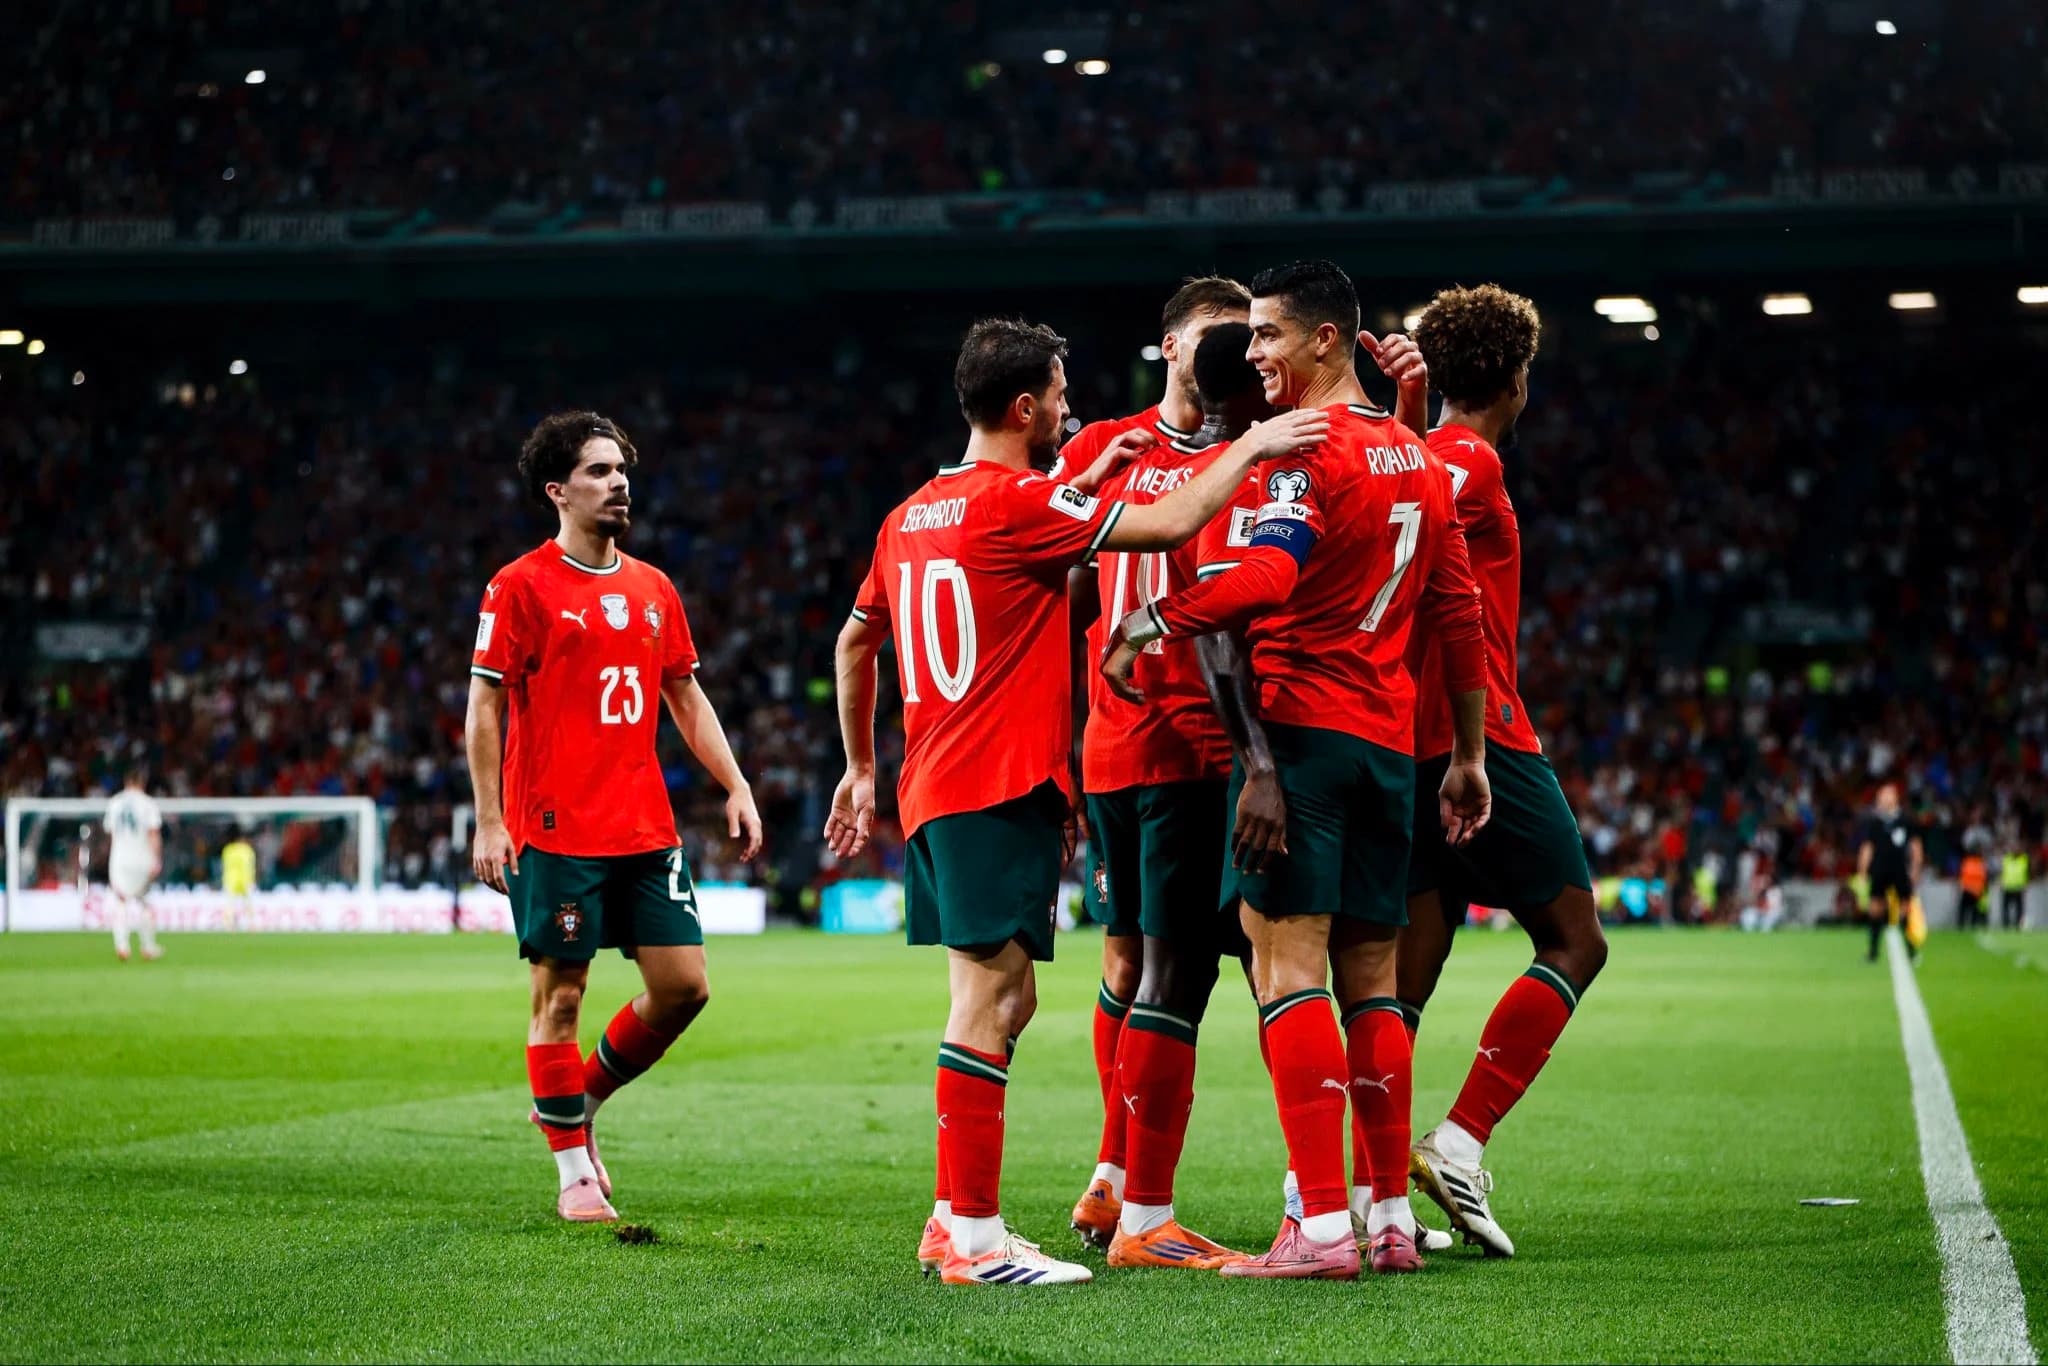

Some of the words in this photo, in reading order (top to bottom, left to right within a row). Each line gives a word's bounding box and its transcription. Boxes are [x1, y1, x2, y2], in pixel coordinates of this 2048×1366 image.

[899, 497, 967, 532] BERNARDO
[1254, 525, 1294, 537] RESPECT
[1358, 502, 1422, 632] 7
[898, 558, 977, 702] 10
[600, 666, 644, 725] 23
[666, 847, 697, 901] 2
